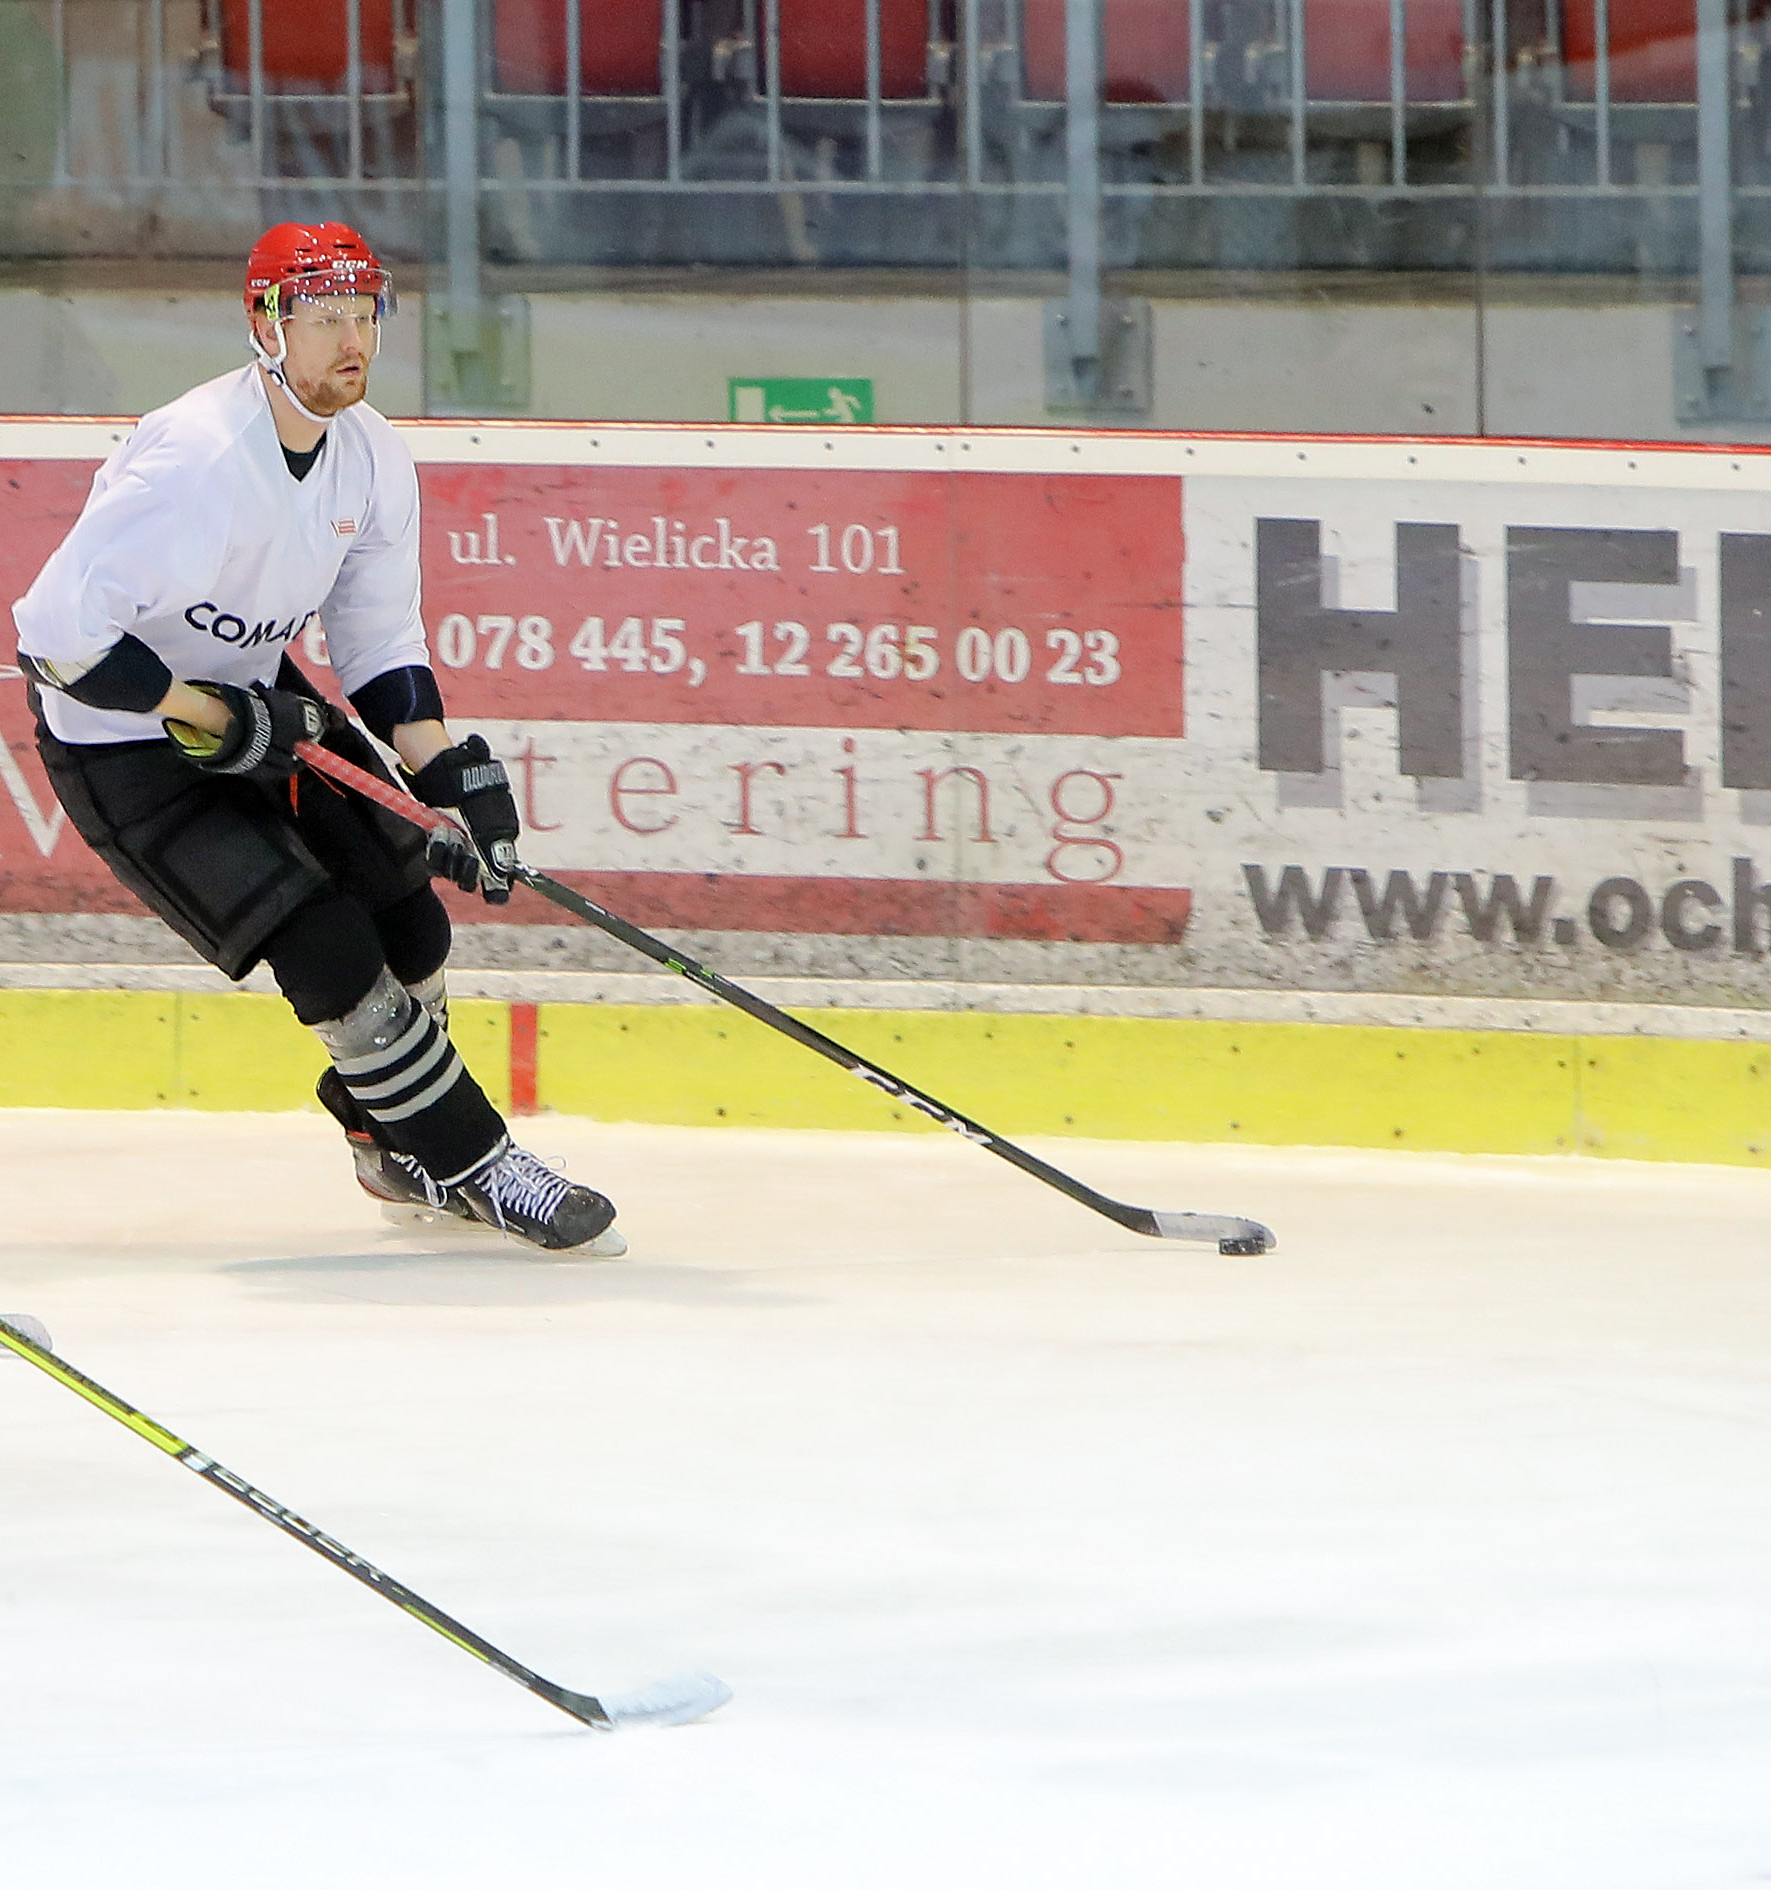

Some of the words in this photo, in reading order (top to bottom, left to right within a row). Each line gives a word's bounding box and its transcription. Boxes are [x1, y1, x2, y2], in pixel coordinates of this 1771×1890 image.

[447, 513, 516, 565] ul.
[543, 516, 780, 571] Wielicka
[807, 523, 907, 575] 101
[437, 613, 555, 671] 078
[569, 616, 707, 687] 445,
[734, 620, 811, 677] 12
[828, 622, 940, 681] 265
[956, 626, 1030, 683] 00
[1046, 628, 1121, 686] 23
[1256, 517, 1771, 790] HE
